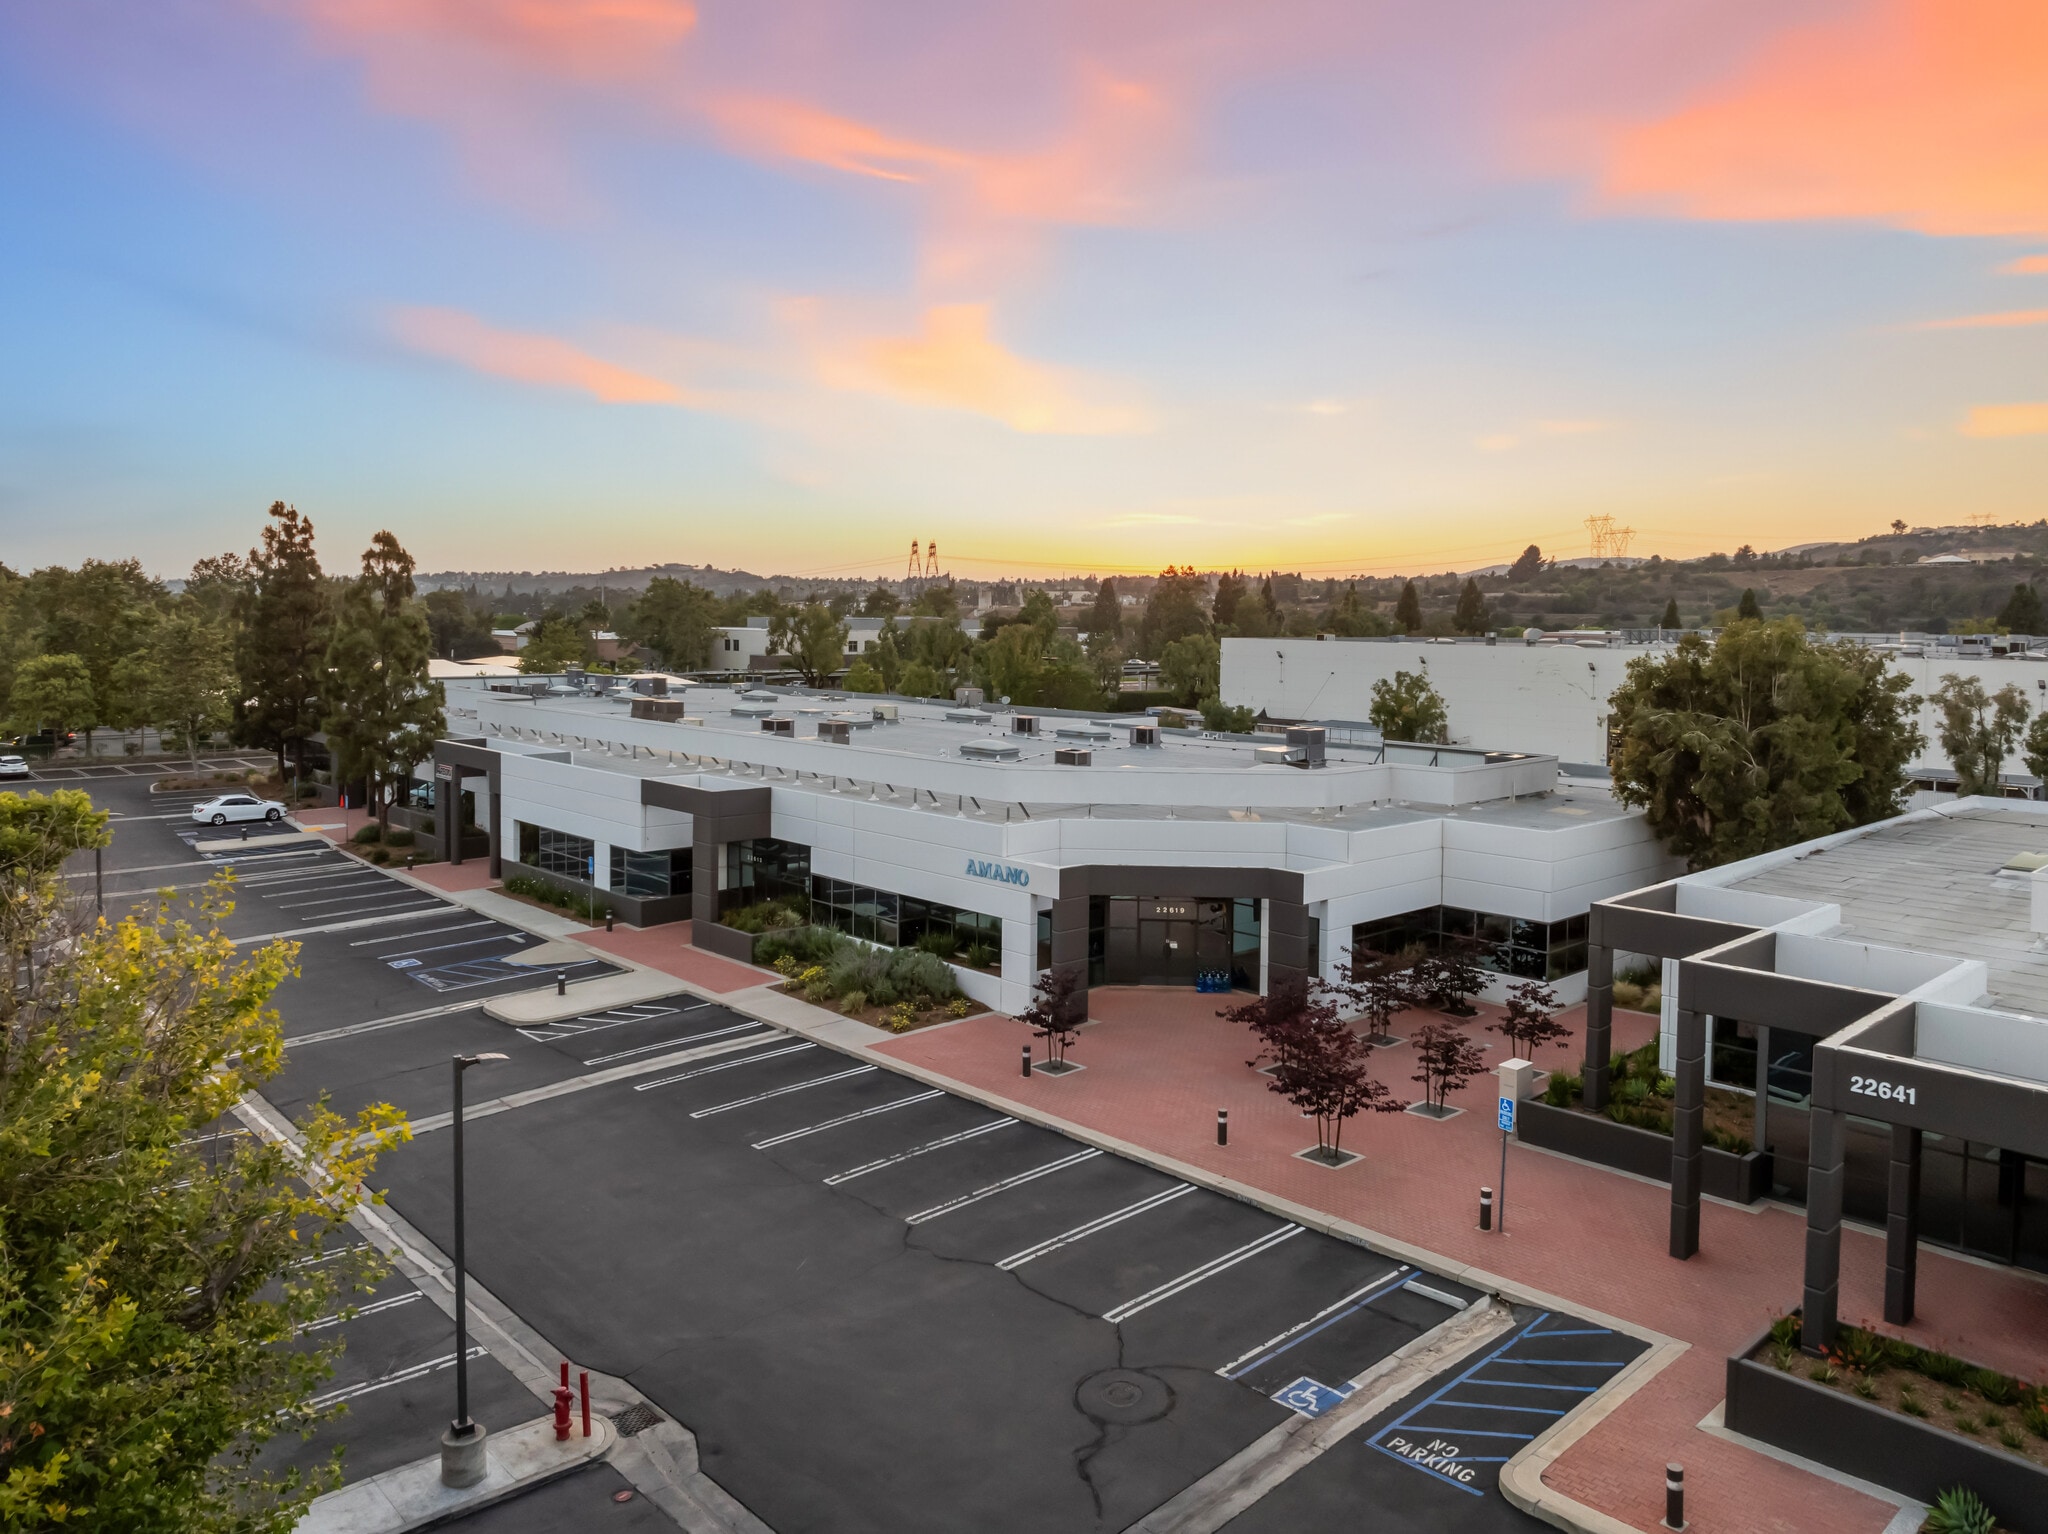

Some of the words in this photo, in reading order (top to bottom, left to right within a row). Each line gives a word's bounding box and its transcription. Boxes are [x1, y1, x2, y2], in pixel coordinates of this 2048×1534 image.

[965, 858, 1030, 887] AMANO
[1156, 906, 1185, 914] 22619
[1850, 1075, 1916, 1105] 22641
[1386, 1437, 1475, 1482] PARKING
[1426, 1439, 1459, 1458] NO
